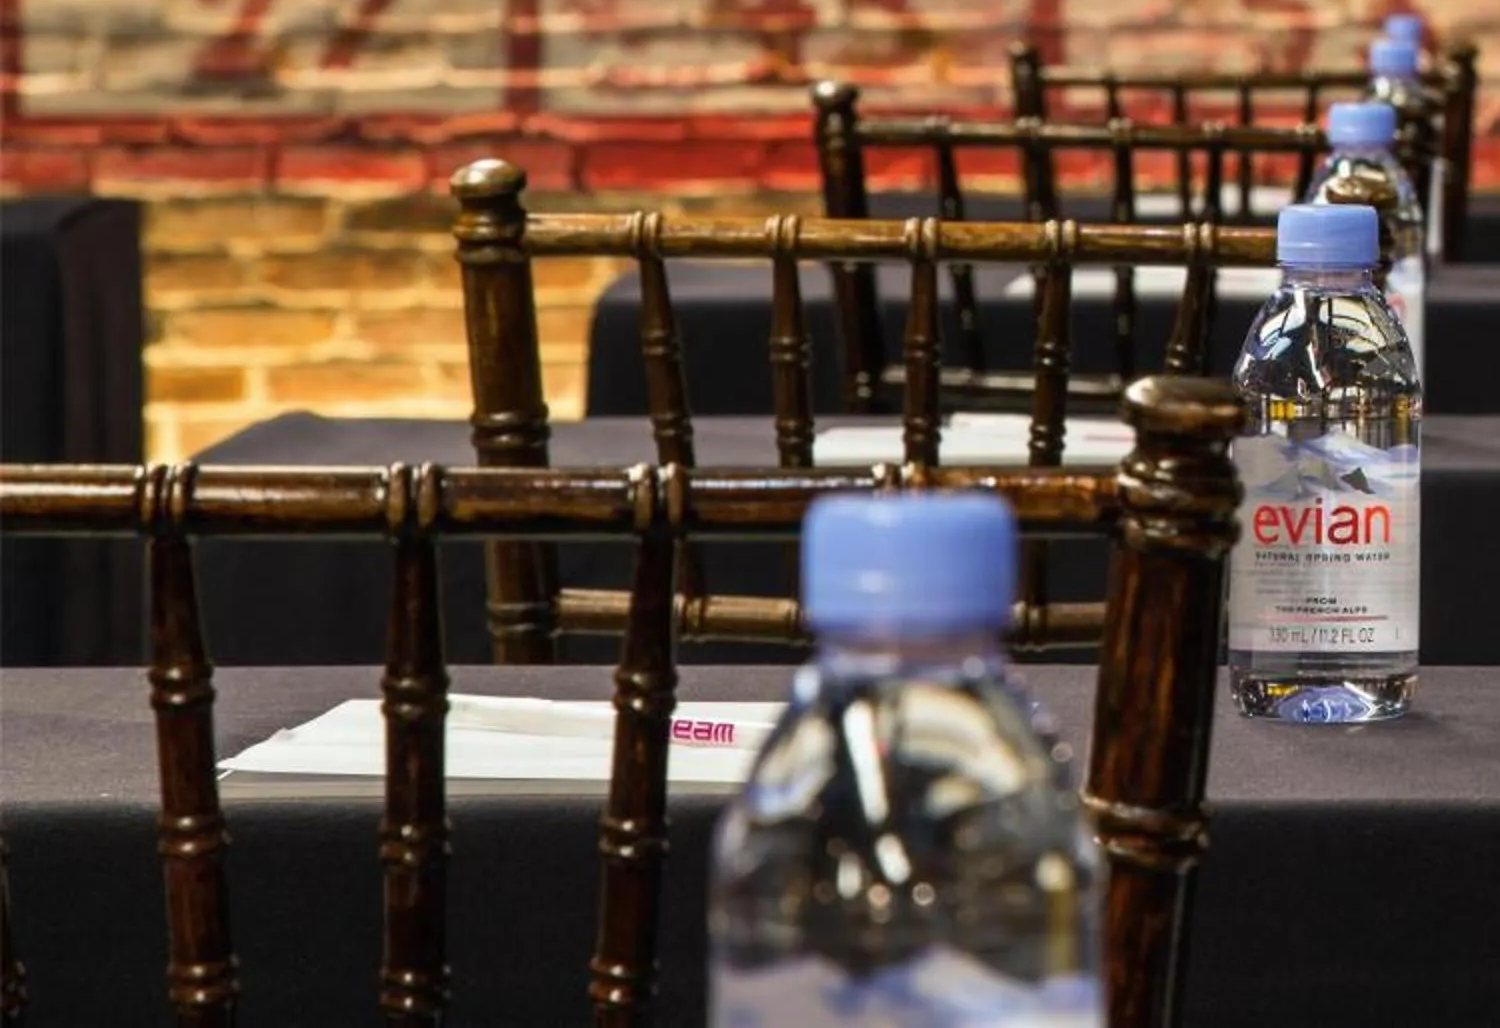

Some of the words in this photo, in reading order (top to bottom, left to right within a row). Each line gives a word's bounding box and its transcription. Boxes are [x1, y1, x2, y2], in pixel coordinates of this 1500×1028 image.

[1254, 497, 1390, 546] evian
[1305, 552, 1351, 563] SPRING
[1305, 597, 1337, 605] FROM
[671, 719, 735, 743] eam
